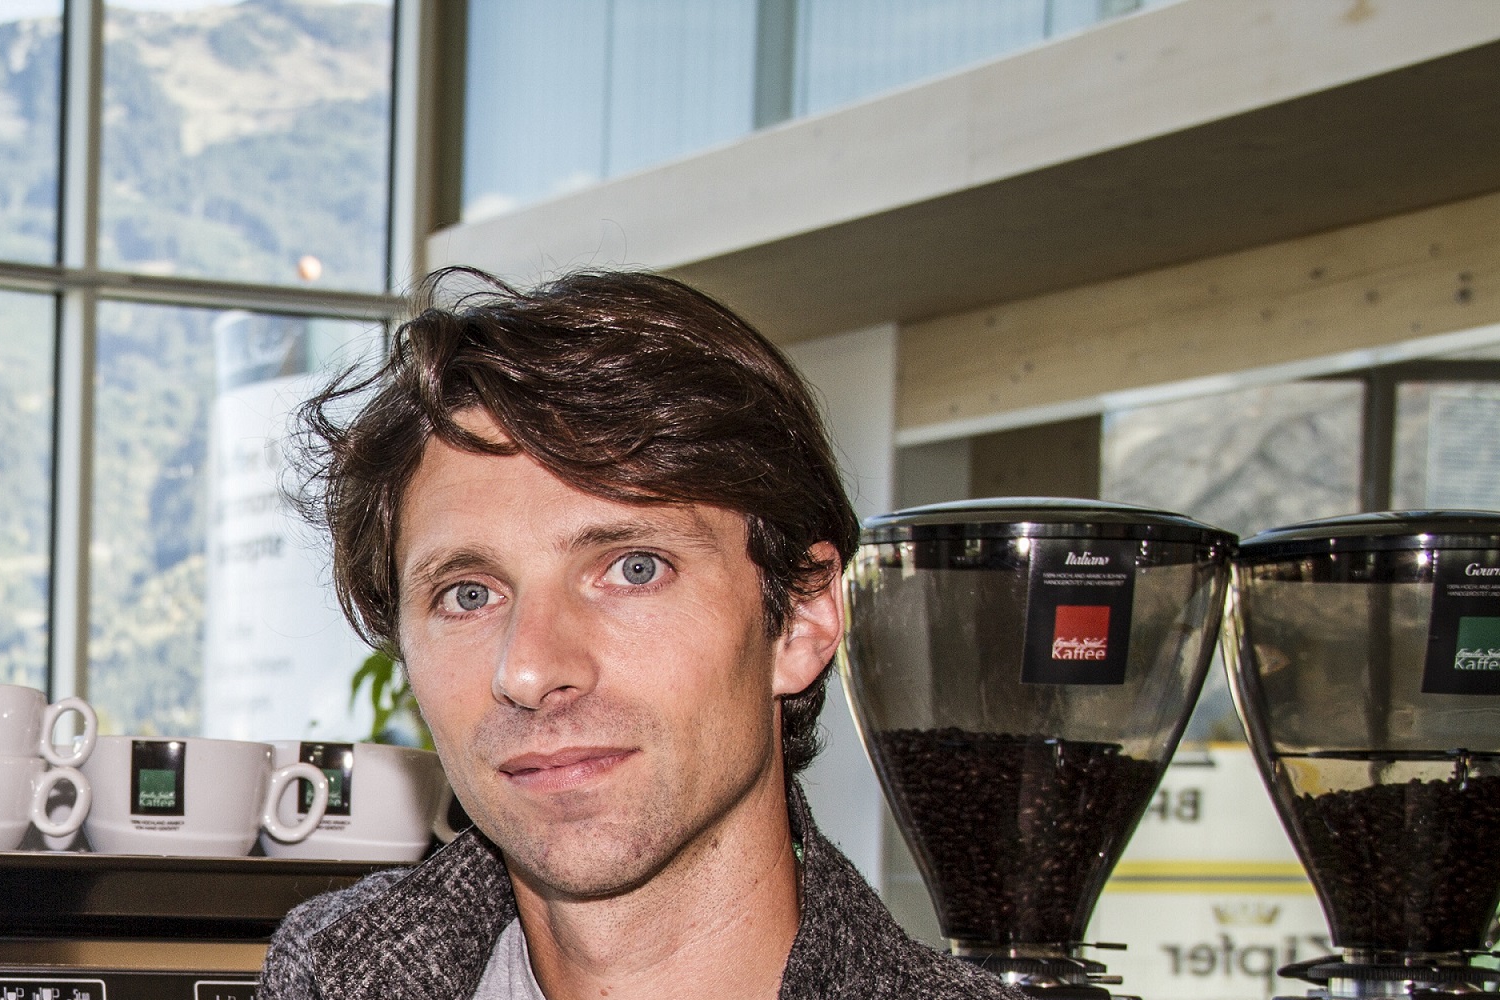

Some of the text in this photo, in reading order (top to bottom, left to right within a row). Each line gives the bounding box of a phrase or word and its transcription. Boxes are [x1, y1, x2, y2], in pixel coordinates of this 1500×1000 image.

[1065, 551, 1110, 566] Italiano
[1051, 647, 1106, 660] Kaffee
[1454, 656, 1500, 671] Kaffe
